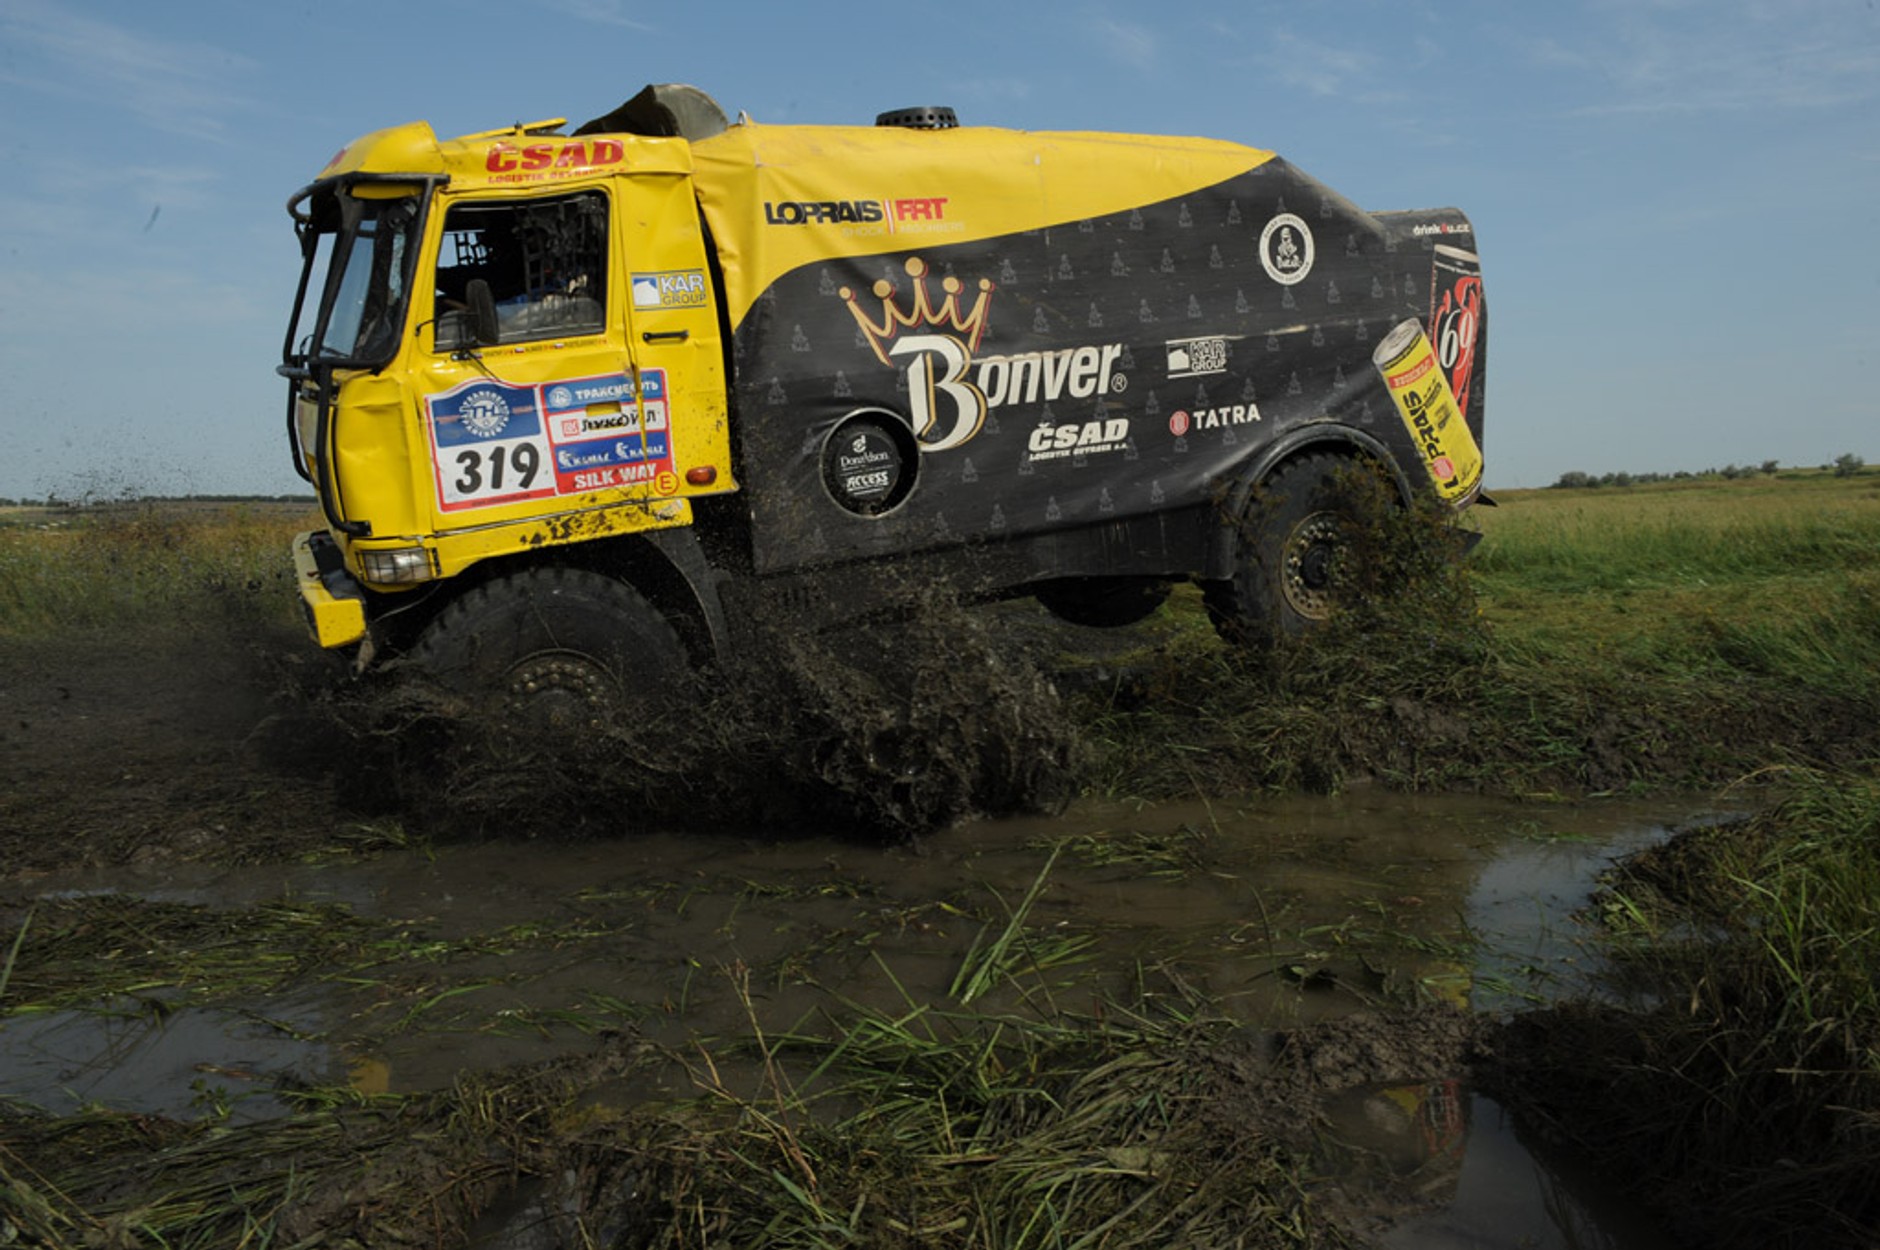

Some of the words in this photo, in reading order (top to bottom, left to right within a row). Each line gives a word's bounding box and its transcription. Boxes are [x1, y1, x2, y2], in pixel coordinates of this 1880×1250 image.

[764, 200, 883, 225] LOPRAIS
[895, 197, 948, 220] FRT
[660, 273, 705, 294] KAR
[662, 293, 707, 305] GROUP
[1439, 308, 1476, 371] 69
[1191, 358, 1227, 372] GROUP
[1193, 403, 1261, 429] TATRA
[1028, 418, 1129, 452] ČSAD
[455, 442, 540, 494] 319
[840, 451, 889, 467] Donaldson
[575, 469, 615, 489] SILK
[619, 462, 657, 481] WAY
[660, 475, 672, 489] E
